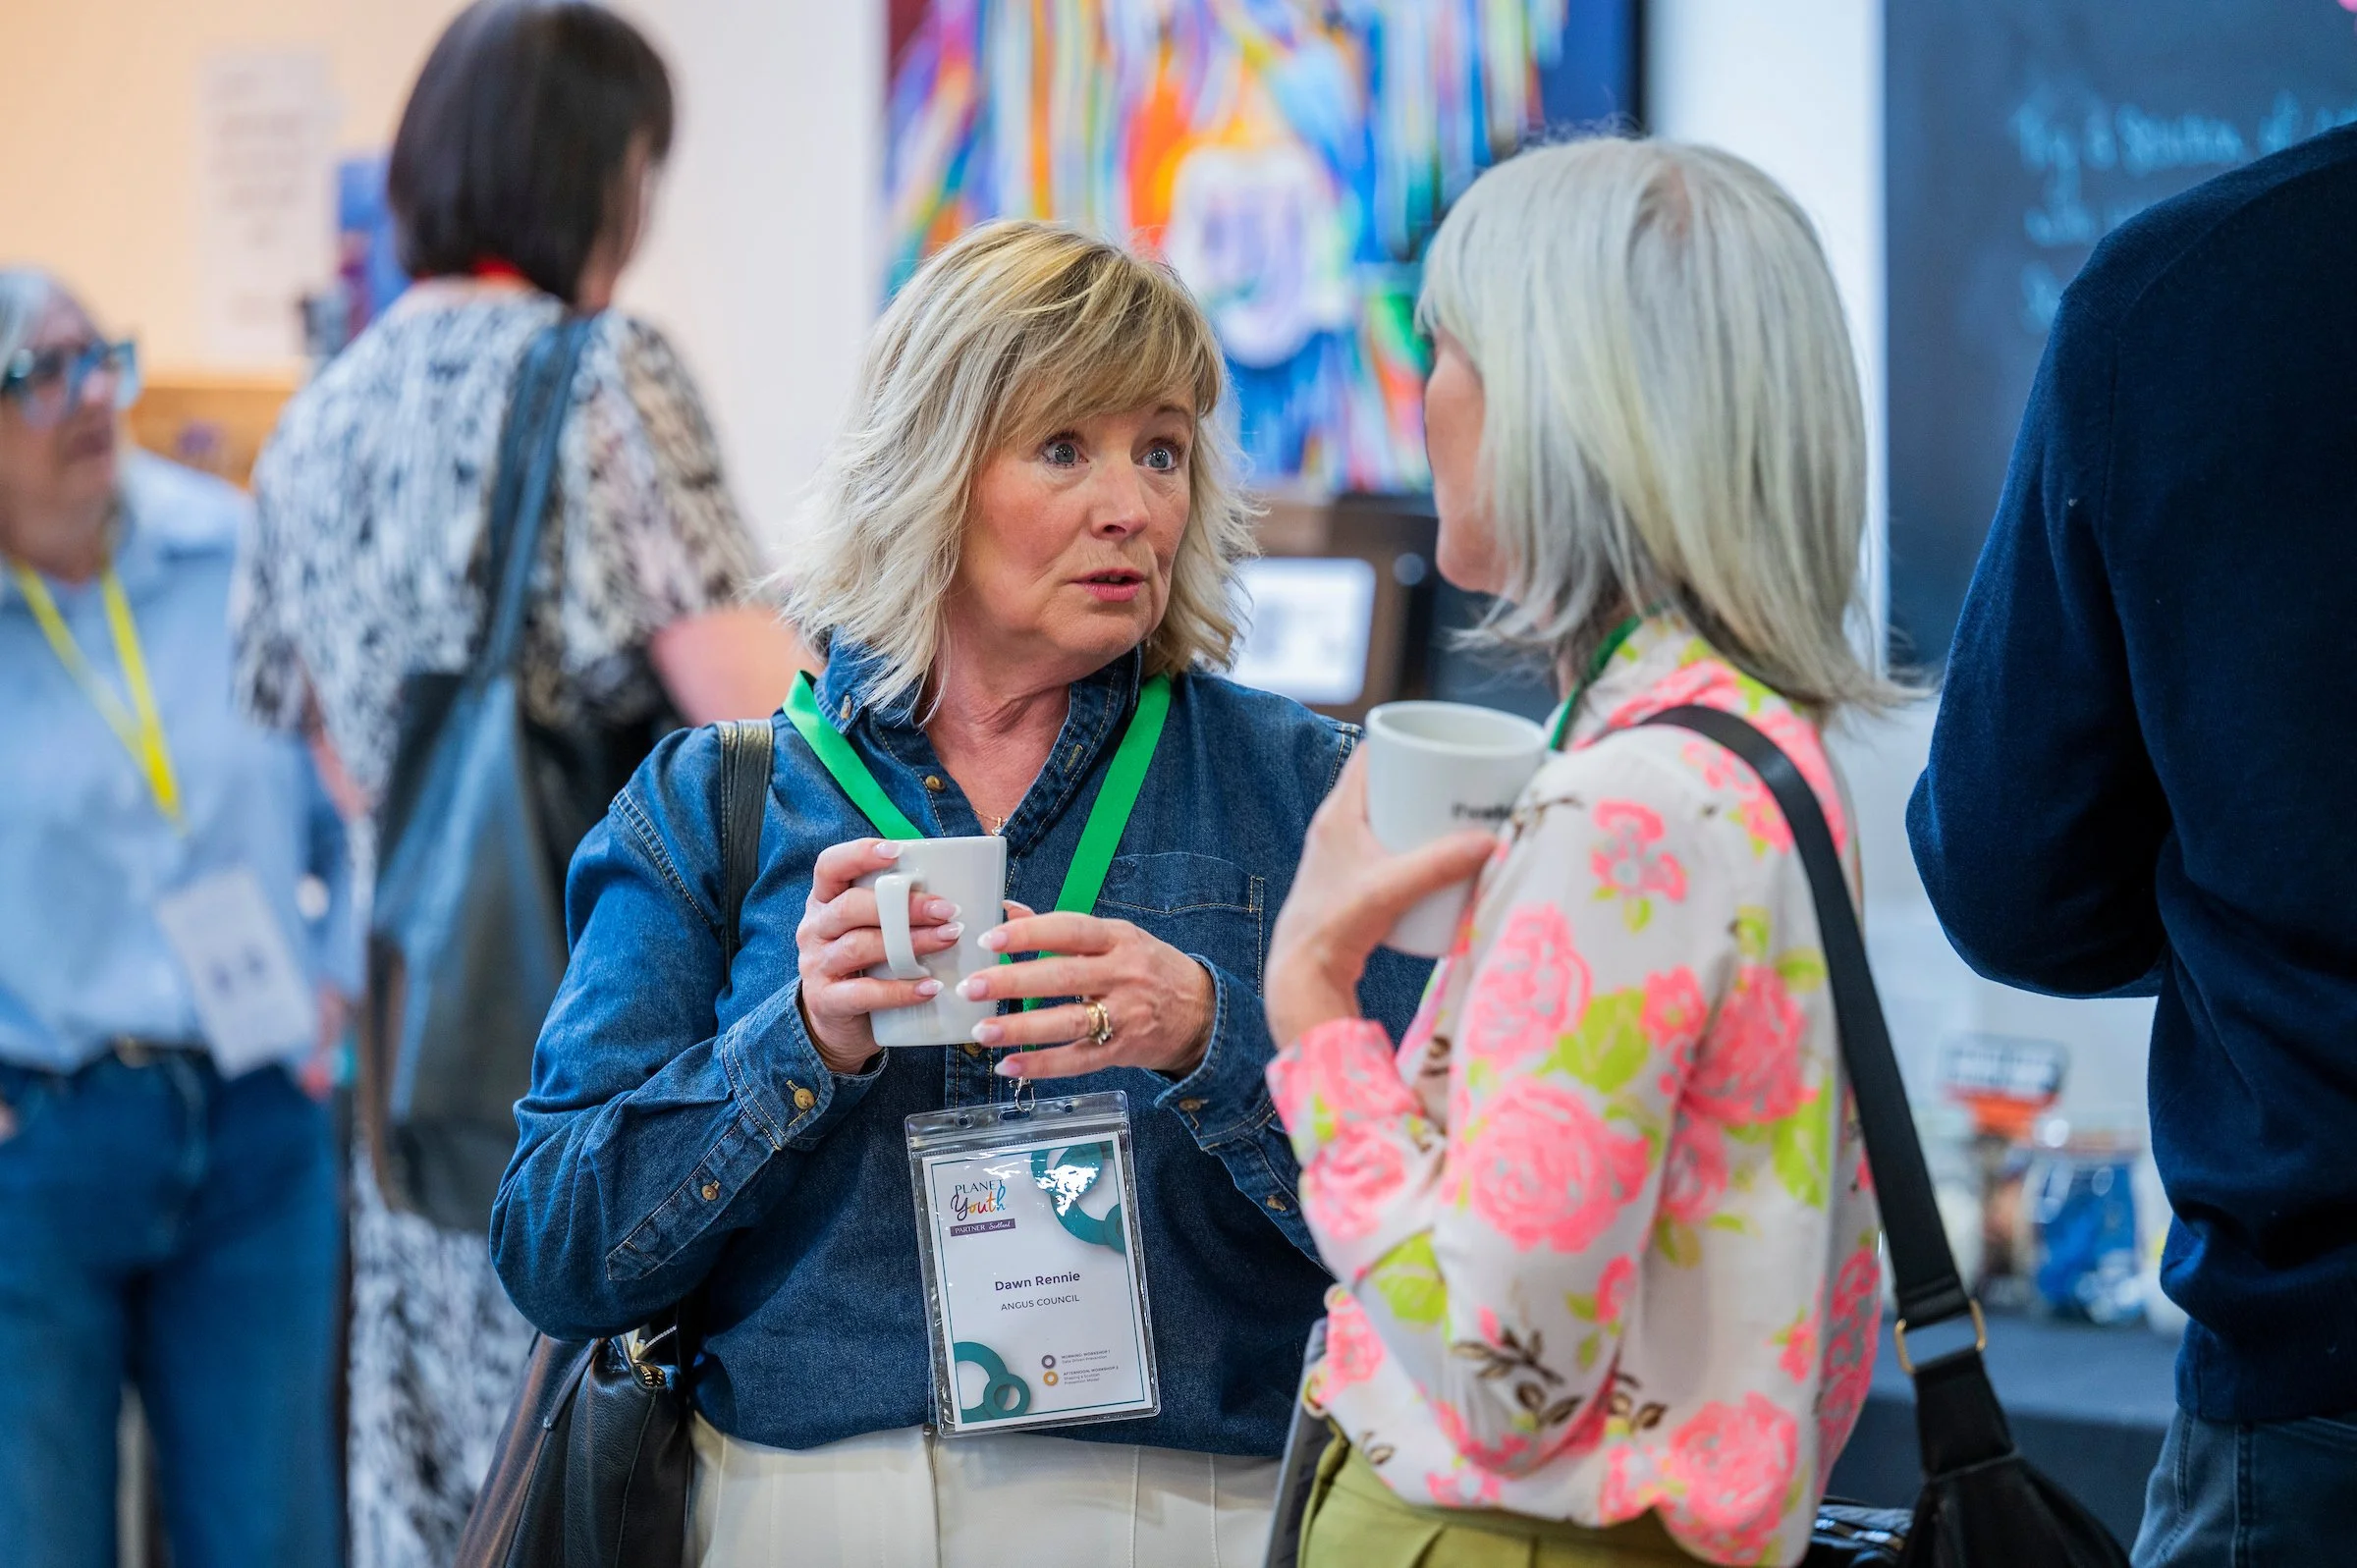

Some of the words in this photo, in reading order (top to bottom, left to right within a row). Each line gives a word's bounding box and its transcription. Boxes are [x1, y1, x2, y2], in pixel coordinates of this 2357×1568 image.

[955, 1179, 1004, 1195] PLANET
[951, 1186, 1006, 1220] Youth
[956, 1224, 986, 1233] PARTNER
[995, 1279, 1032, 1291] Dawn
[1035, 1271, 1080, 1286] Rennie
[1001, 1300, 1034, 1311] ANGUS
[1036, 1294, 1079, 1307] COUNCIL
